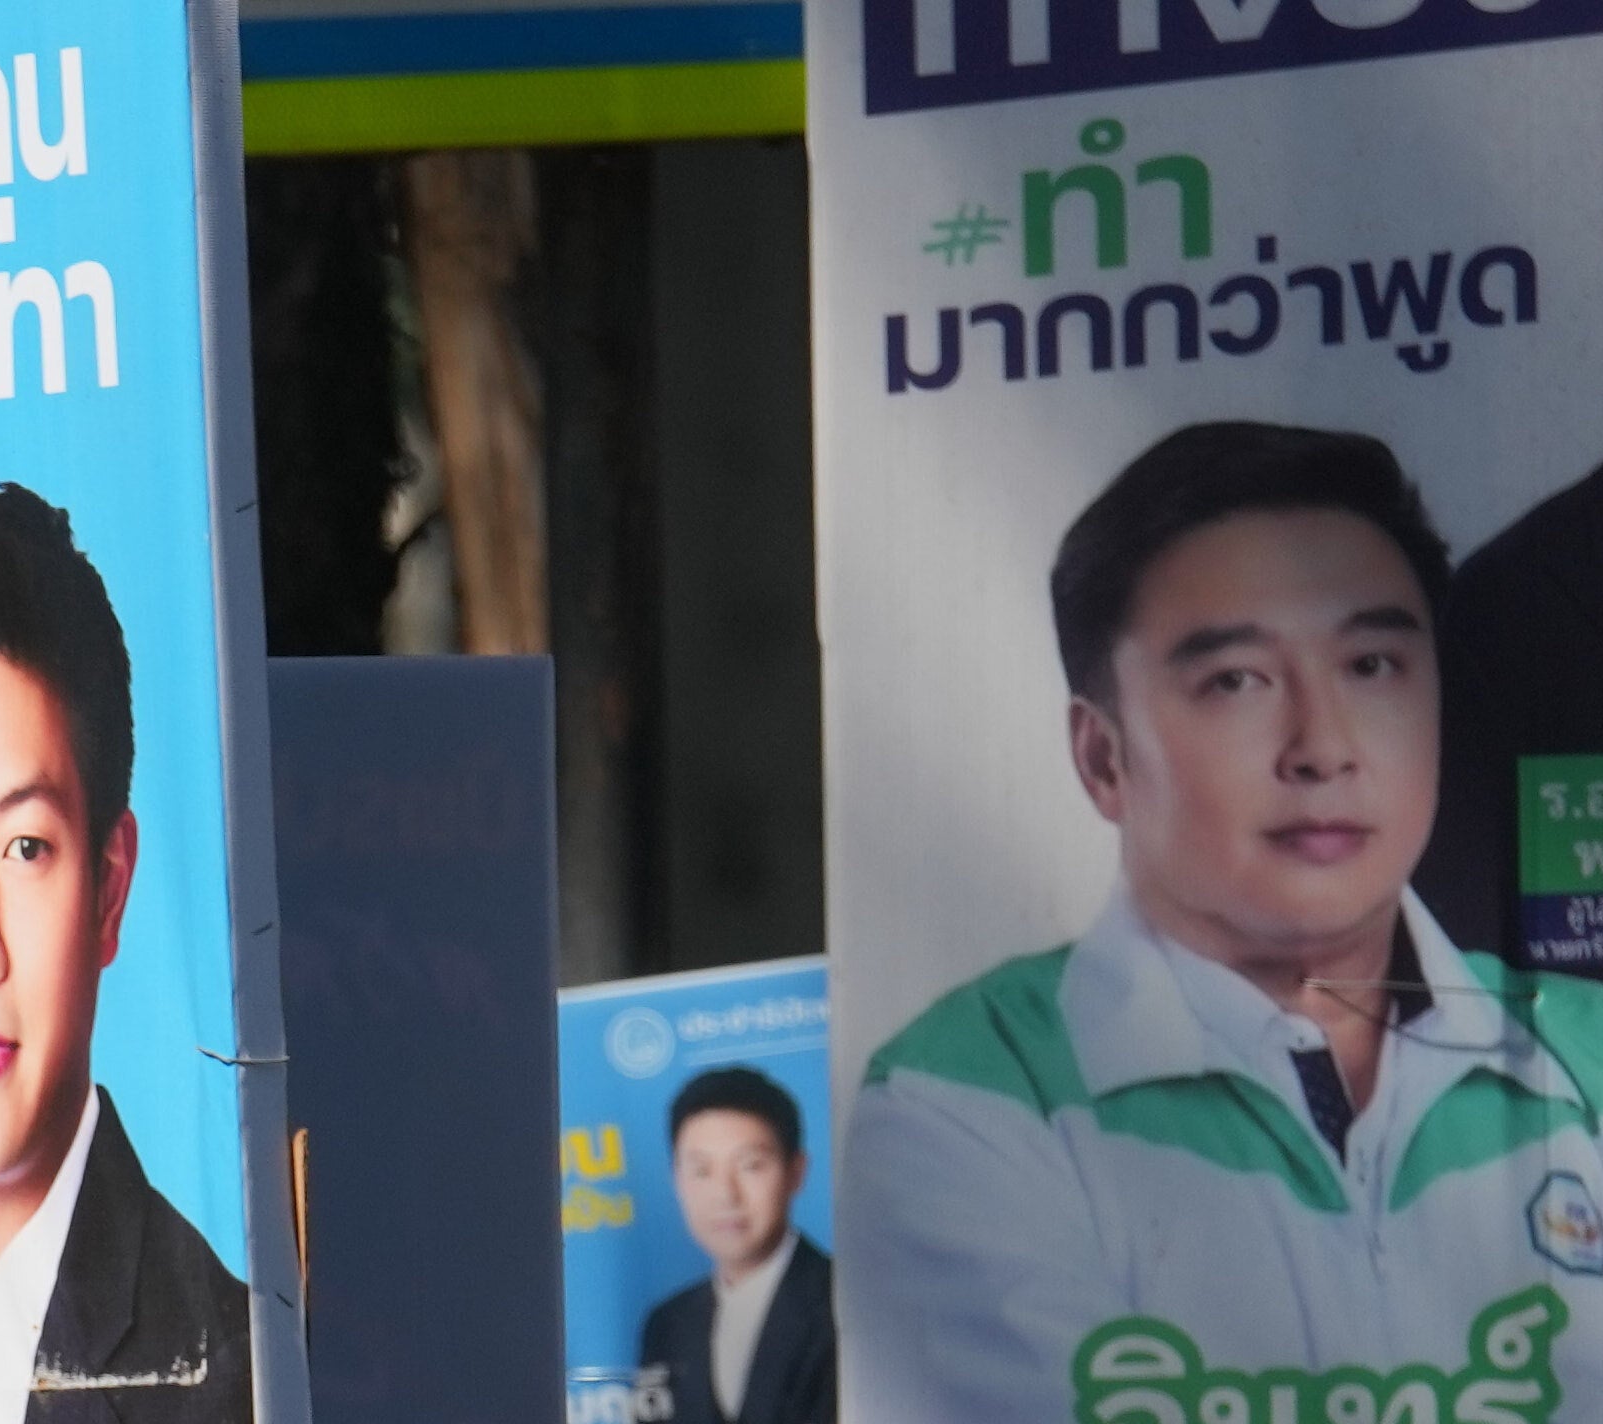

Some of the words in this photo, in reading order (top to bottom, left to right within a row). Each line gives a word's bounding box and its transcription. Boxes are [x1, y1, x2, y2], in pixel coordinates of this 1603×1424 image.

[921, 117, 1213, 277] #ทำ
[884, 234, 1539, 395] มากกว่าพูด
